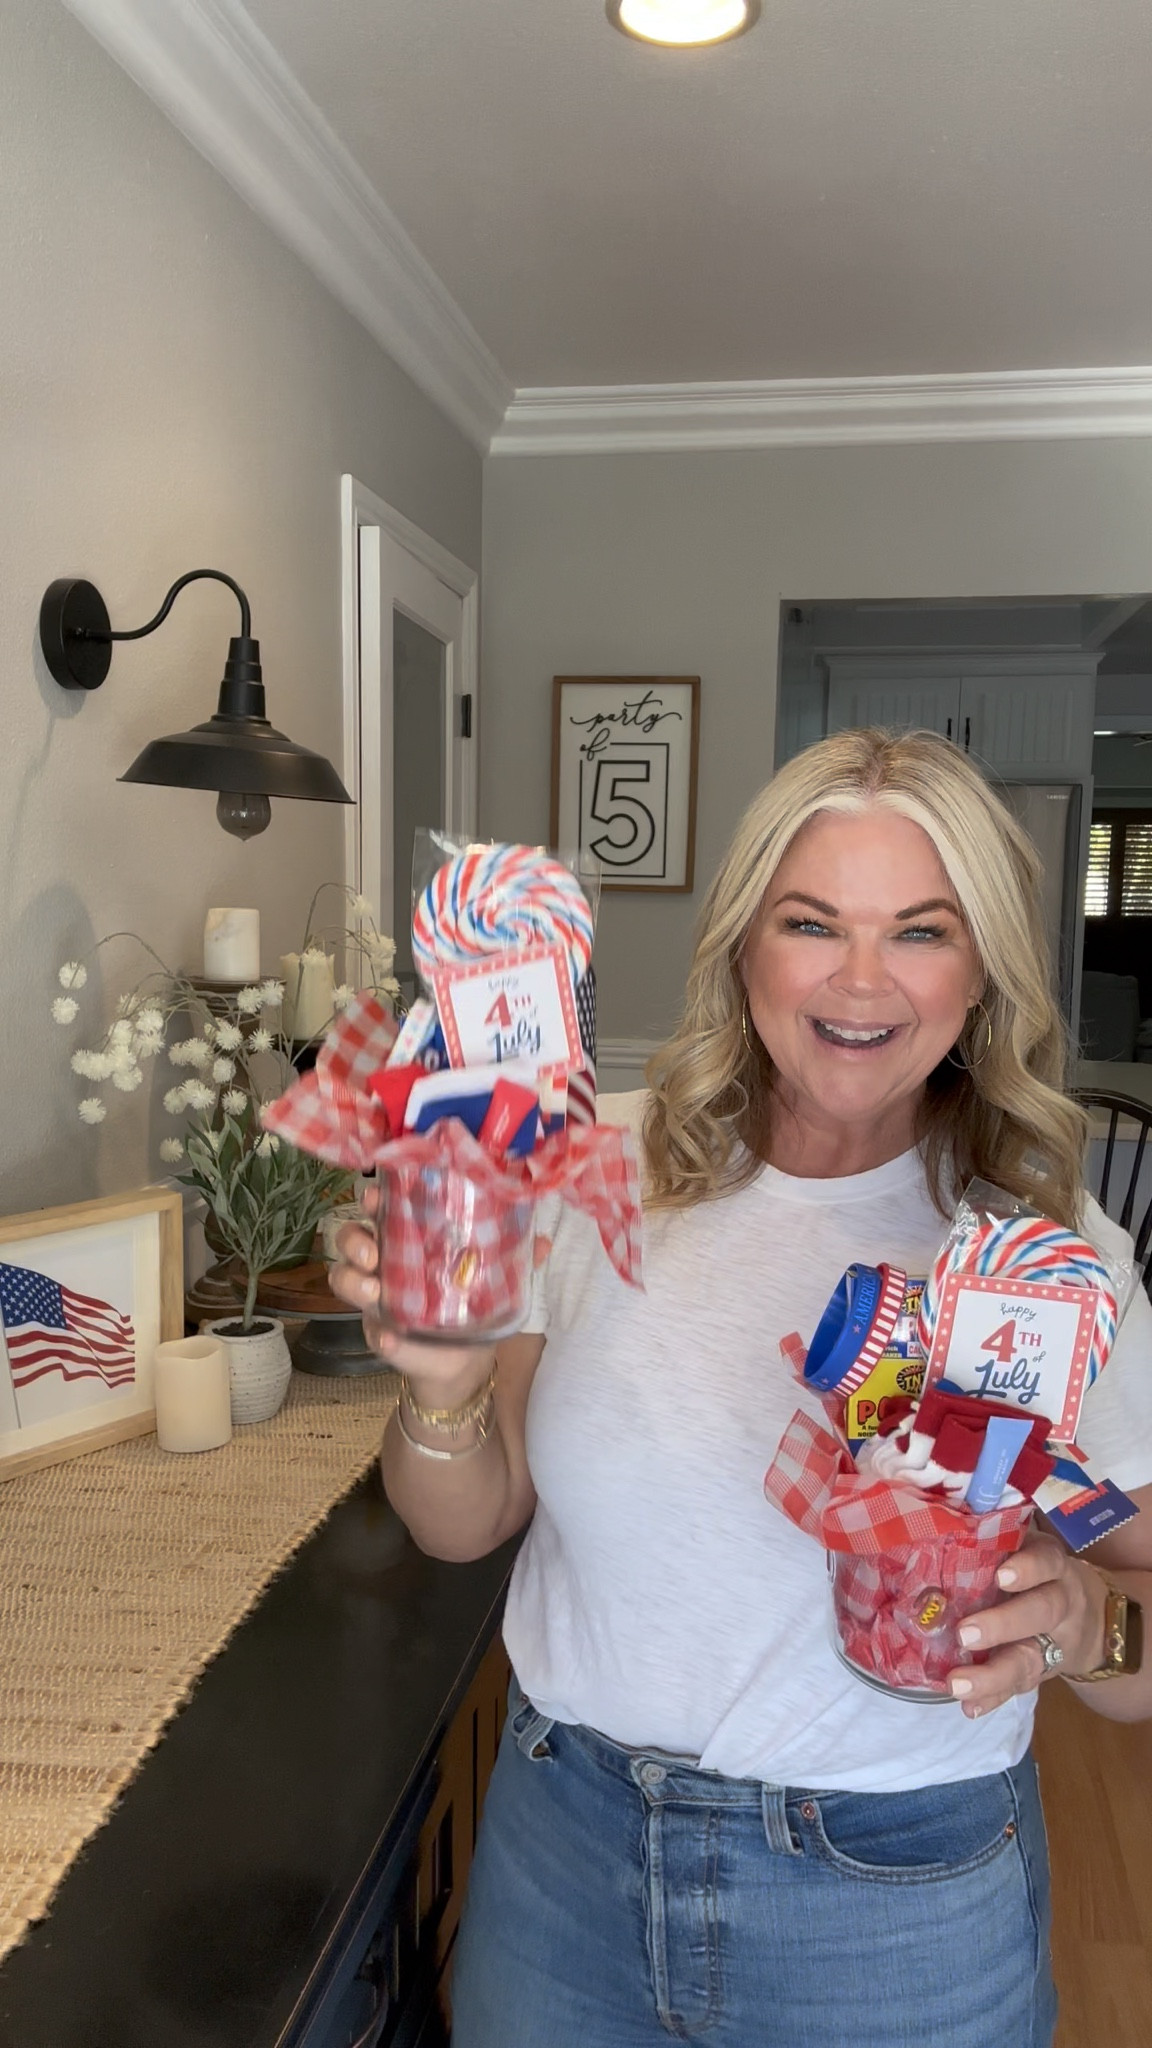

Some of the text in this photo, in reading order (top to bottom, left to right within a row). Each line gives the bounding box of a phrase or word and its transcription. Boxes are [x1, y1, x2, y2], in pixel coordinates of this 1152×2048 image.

[570, 690, 682, 733] party
[579, 727, 611, 761] of
[589, 760, 656, 867] 5
[1000, 1302, 1037, 1322] happy
[1032, 1350, 1047, 1363] of
[965, 1358, 1041, 1405] July
